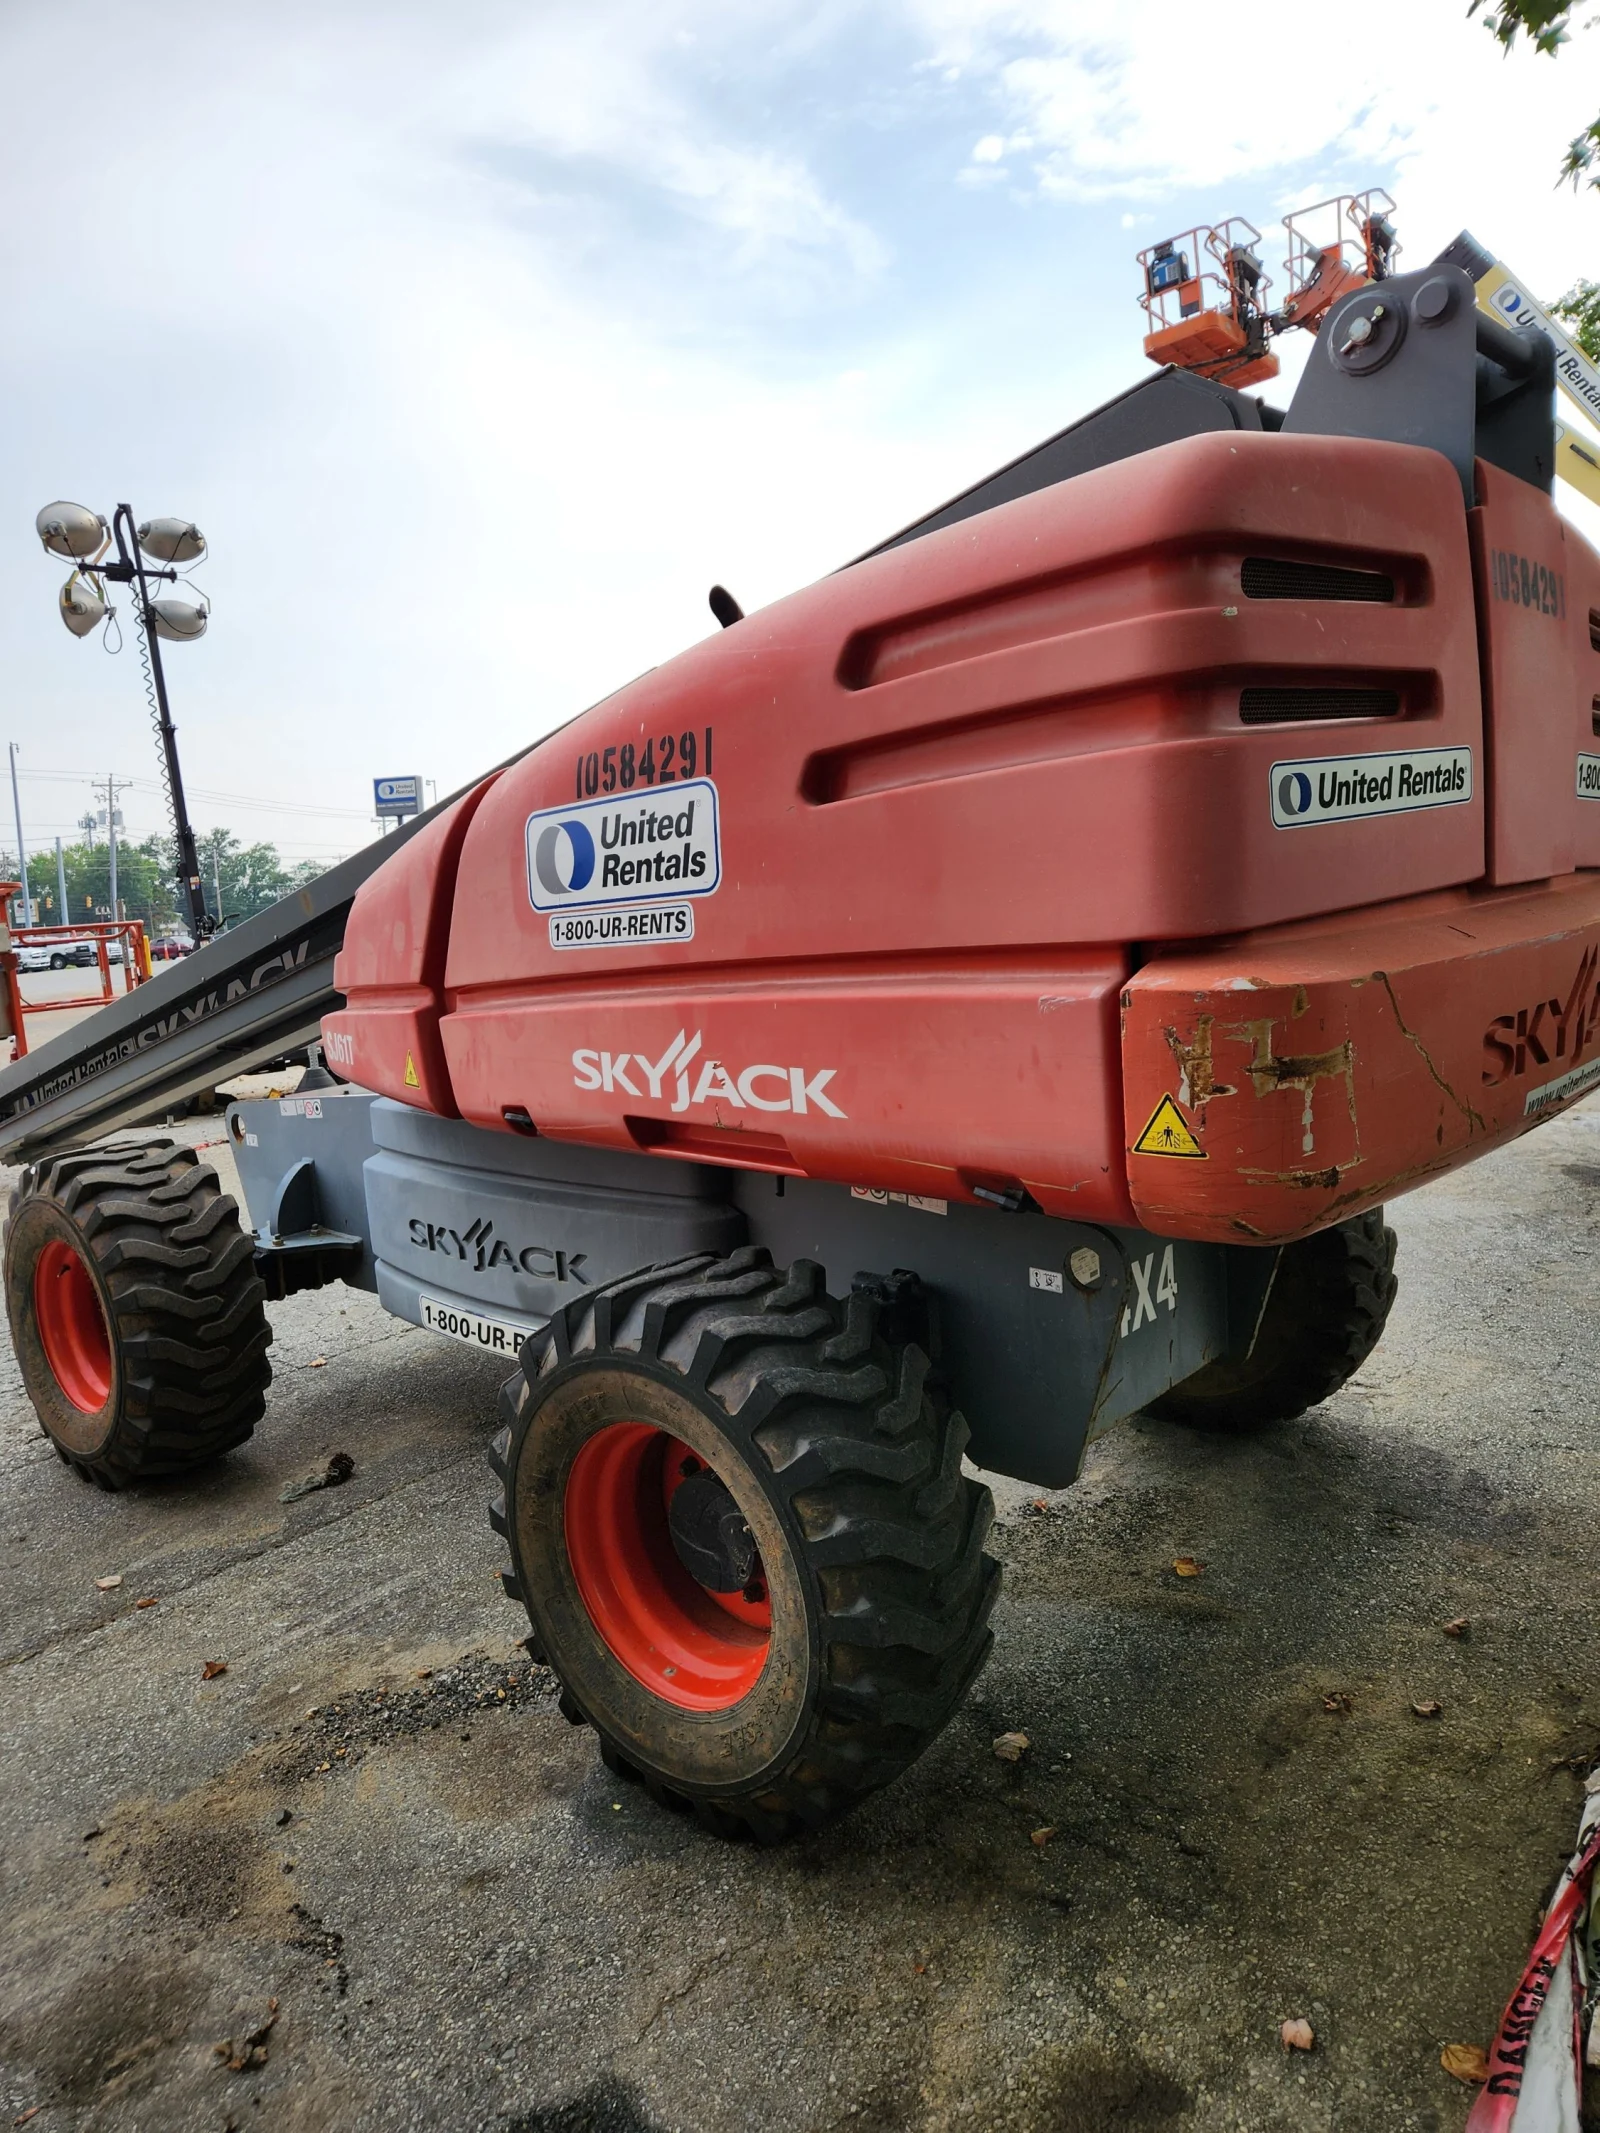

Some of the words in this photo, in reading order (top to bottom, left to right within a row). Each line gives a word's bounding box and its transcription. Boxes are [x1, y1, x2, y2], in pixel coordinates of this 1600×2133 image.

[1559, 357, 1600, 412] Renta
[1491, 547, 1566, 620] 10584291
[575, 726, 713, 799] 10584291
[1318, 766, 1394, 809] United
[1398, 758, 1465, 798] Rentals
[600, 801, 695, 850] United
[602, 843, 706, 888] Rentals
[554, 910, 687, 942] 1-800-UR-RENTS
[326, 1031, 354, 1066] SJ61T
[572, 1028, 848, 1118] SKYJACK
[408, 1217, 592, 1286] SKYJACK
